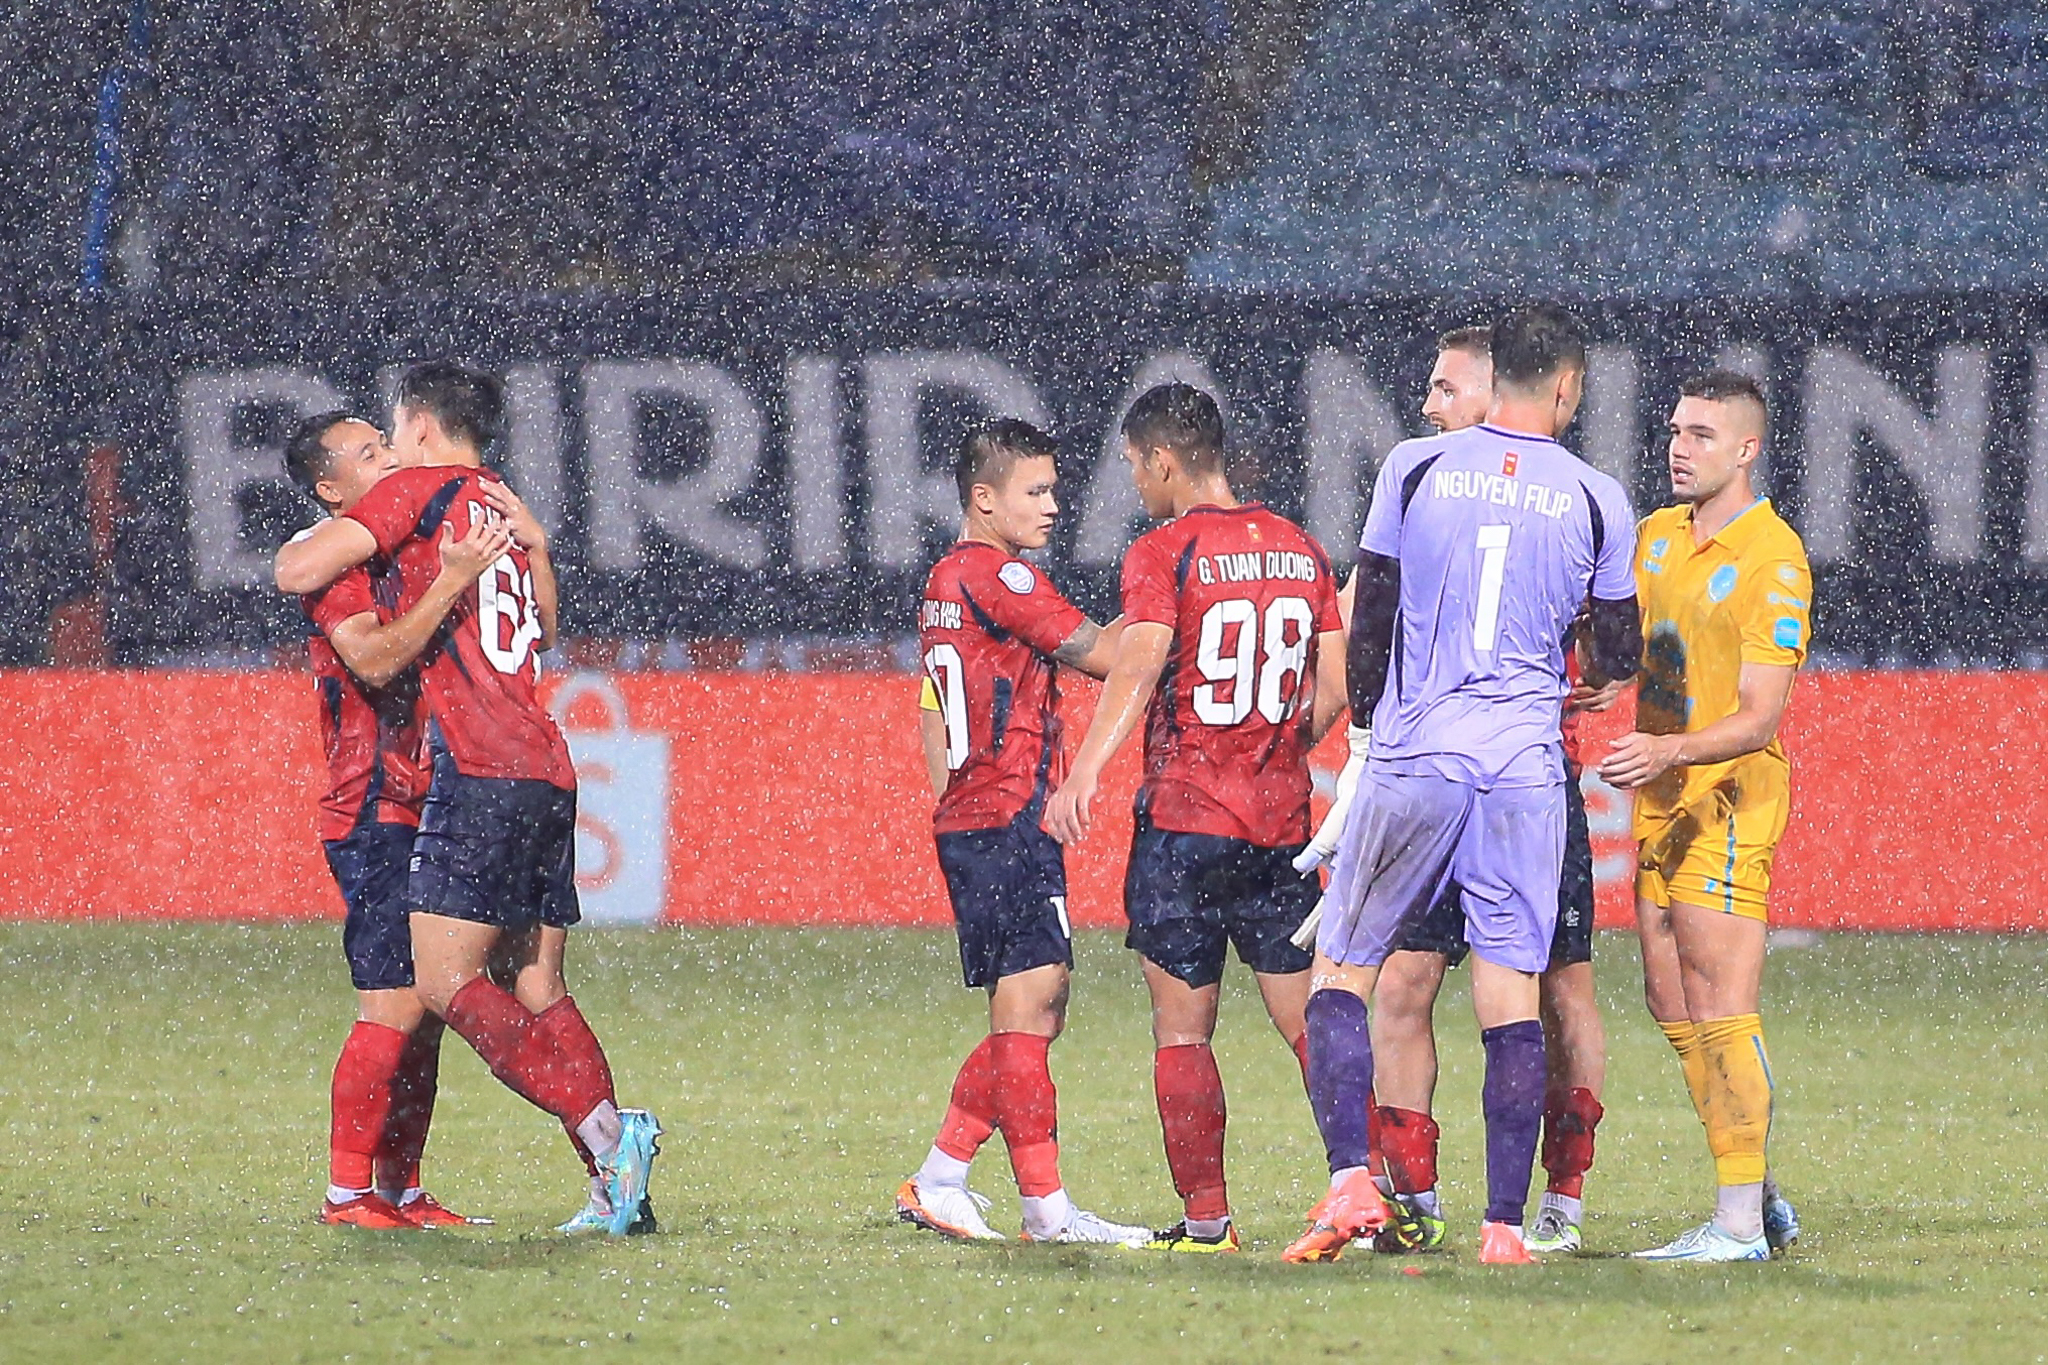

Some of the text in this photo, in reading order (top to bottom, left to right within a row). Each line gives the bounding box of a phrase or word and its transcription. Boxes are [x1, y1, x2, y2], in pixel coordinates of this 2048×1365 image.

[1433, 470, 1573, 519] NGUYEN FILIP
[1198, 551, 1316, 584] G. TUAN DUONG
[1473, 524, 1512, 651] 1
[1192, 597, 1314, 726] 98
